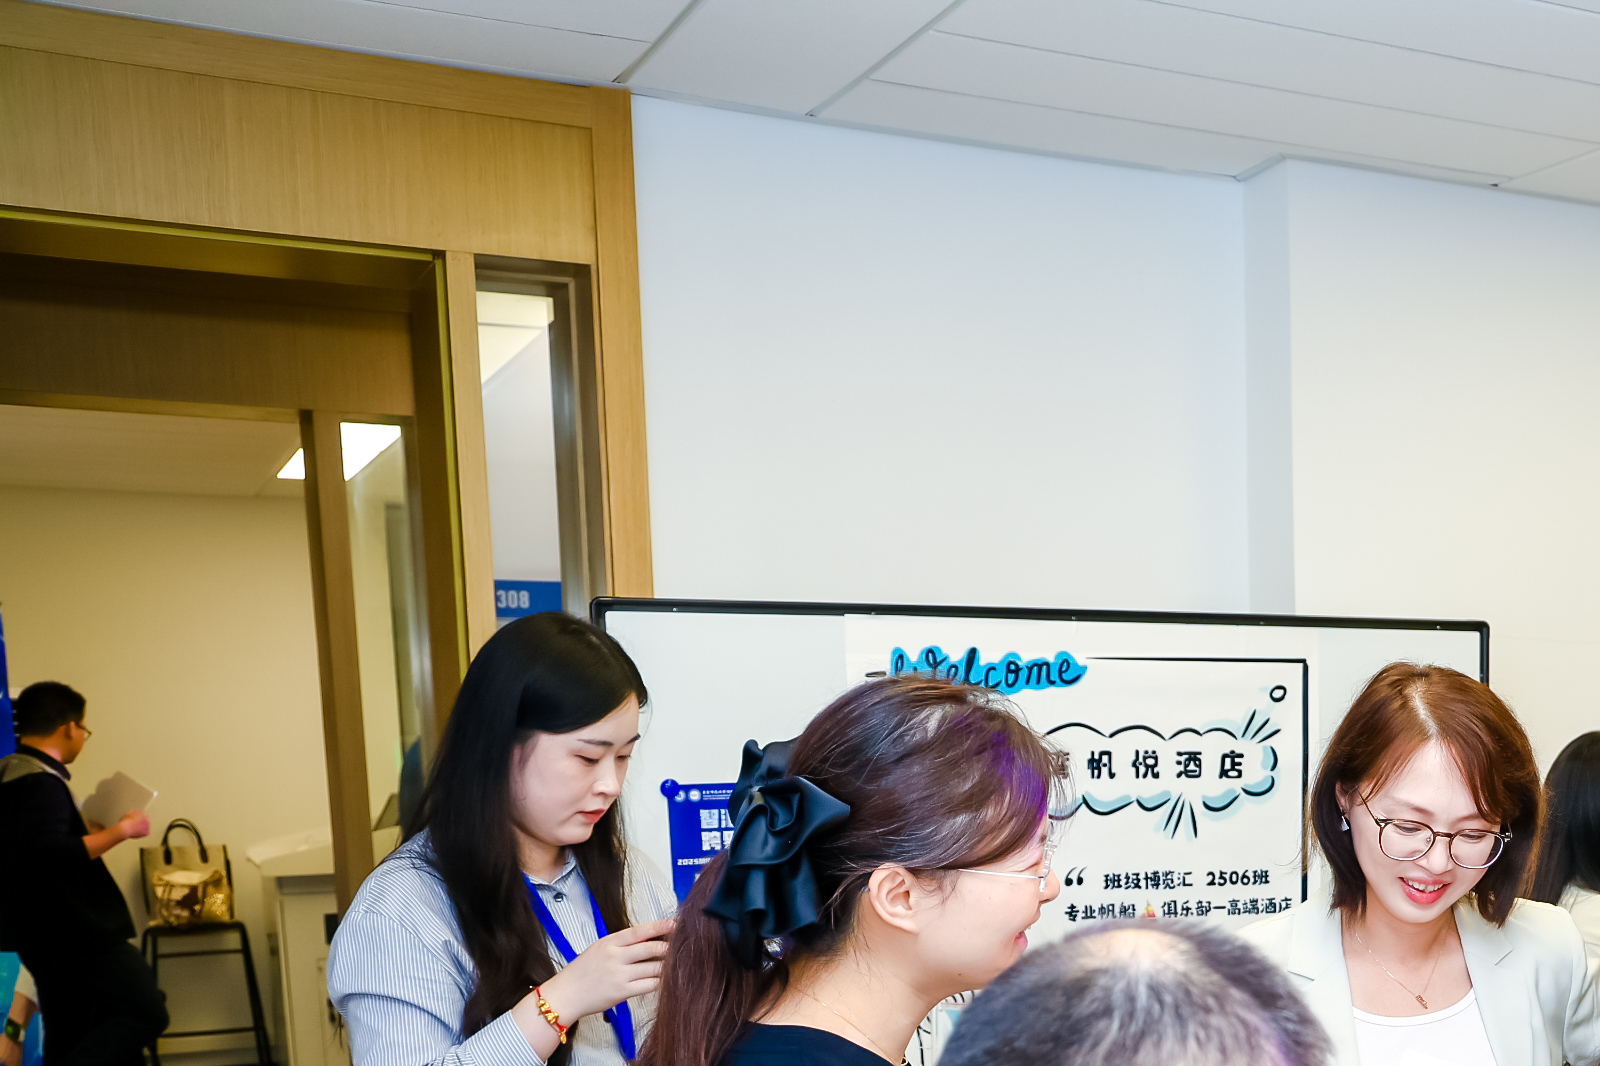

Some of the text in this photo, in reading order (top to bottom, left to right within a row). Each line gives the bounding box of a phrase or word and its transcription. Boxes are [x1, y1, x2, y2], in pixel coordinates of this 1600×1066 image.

[496, 590, 530, 609] 308
[1103, 869, 1270, 890] 班级博览汇 2506班
[1064, 902, 1137, 922] 专业帆船
